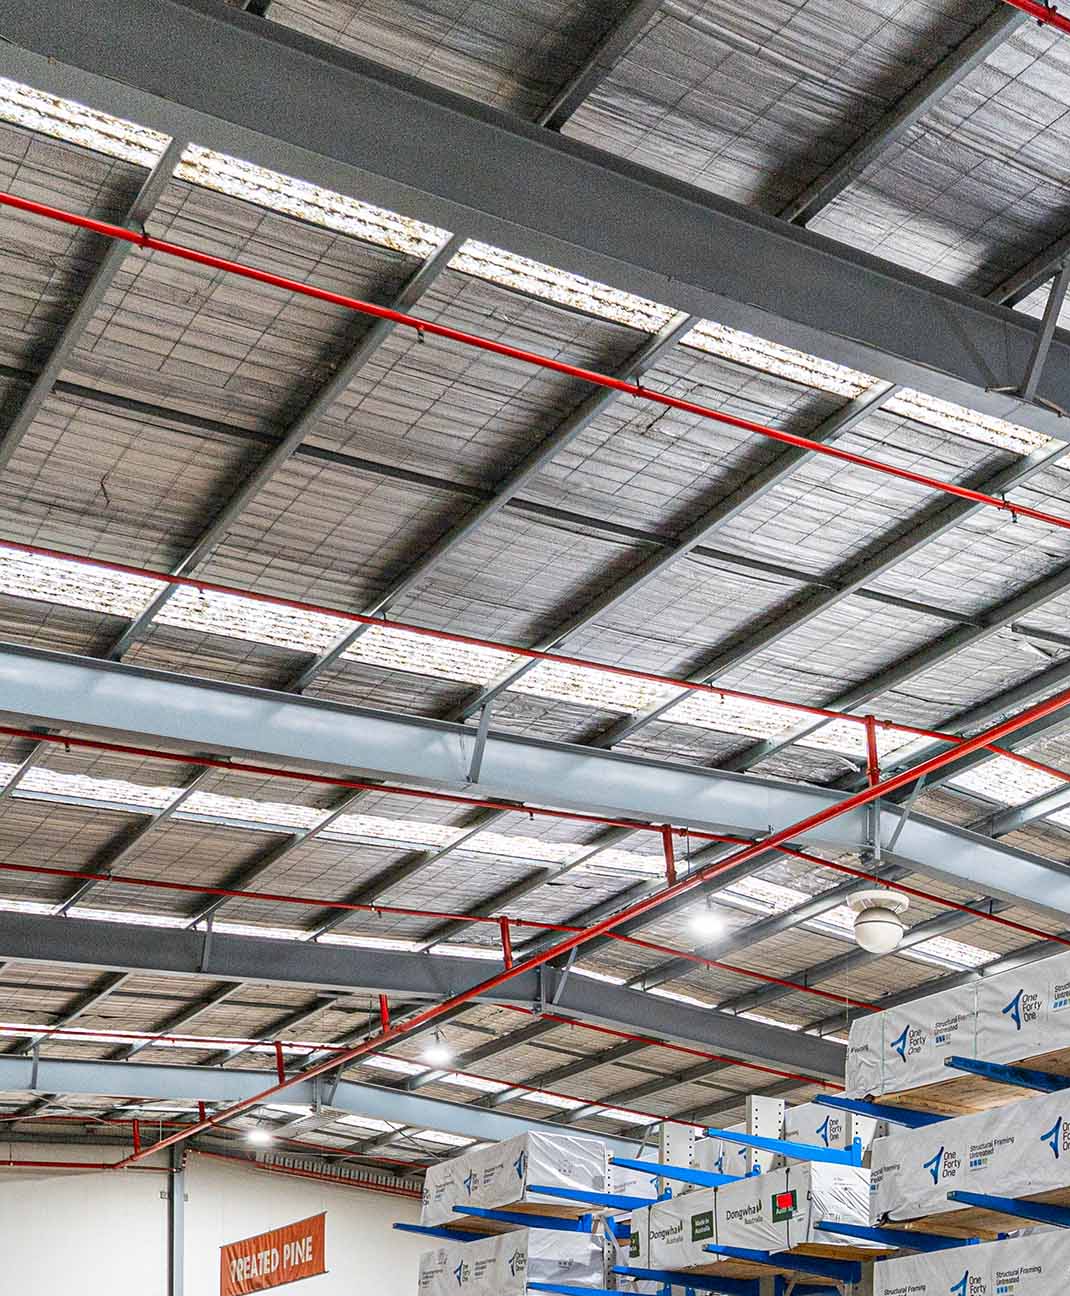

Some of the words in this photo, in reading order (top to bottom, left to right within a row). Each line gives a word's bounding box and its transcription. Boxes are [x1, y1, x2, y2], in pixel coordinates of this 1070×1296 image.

[1022, 992, 1038, 1002] One
[1022, 1000, 1042, 1012] Forty
[1023, 1012, 1037, 1023] One
[909, 1029, 922, 1038] One
[909, 1035, 926, 1046] Forty
[908, 1046, 921, 1056] One
[970, 1141, 993, 1151] Structural
[994, 1136, 1015, 1147] Framing
[943, 1151, 957, 1161] One
[943, 1159, 962, 1170] Forty
[942, 1169, 956, 1178] One
[283, 1235, 313, 1269] PINE
[996, 1269, 1020, 1279] Structural
[969, 1275, 982, 1285] One
[884, 1286, 908, 1296] Structural
[969, 1284, 986, 1295] Forty
